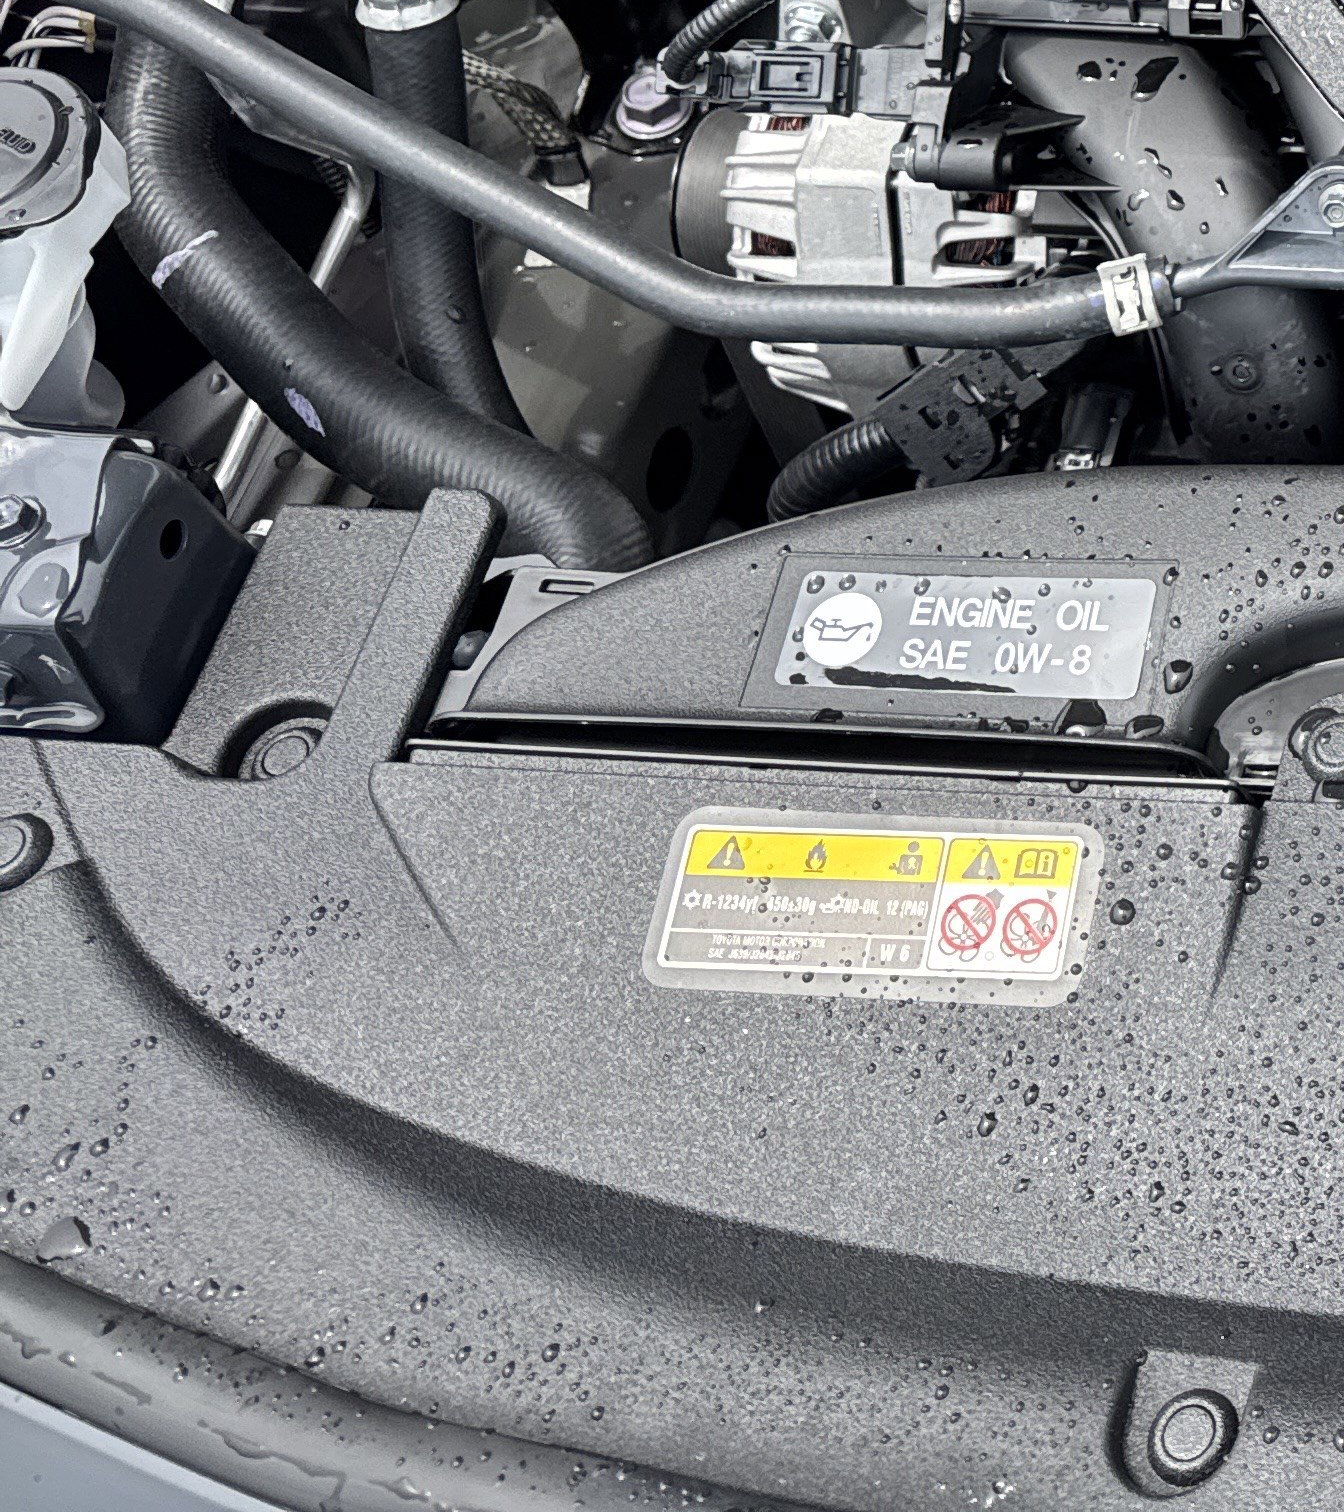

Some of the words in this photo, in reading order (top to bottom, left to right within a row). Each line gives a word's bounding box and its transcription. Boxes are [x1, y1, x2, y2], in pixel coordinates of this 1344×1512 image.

[908, 597, 1036, 630] ENGINE
[1055, 600, 1110, 632] OIL
[899, 639, 972, 670] SAE
[994, 642, 1092, 676] 0W-8
[702, 893, 759, 916] R-1234yf
[885, 898, 898, 917] 12
[899, 898, 929, 920] (PAG)
[711, 933, 743, 947] TOYOTA
[743, 934, 772, 948] MOTOR
[707, 947, 724, 960] SAE
[880, 945, 897, 962] W
[898, 946, 910, 963] 6
